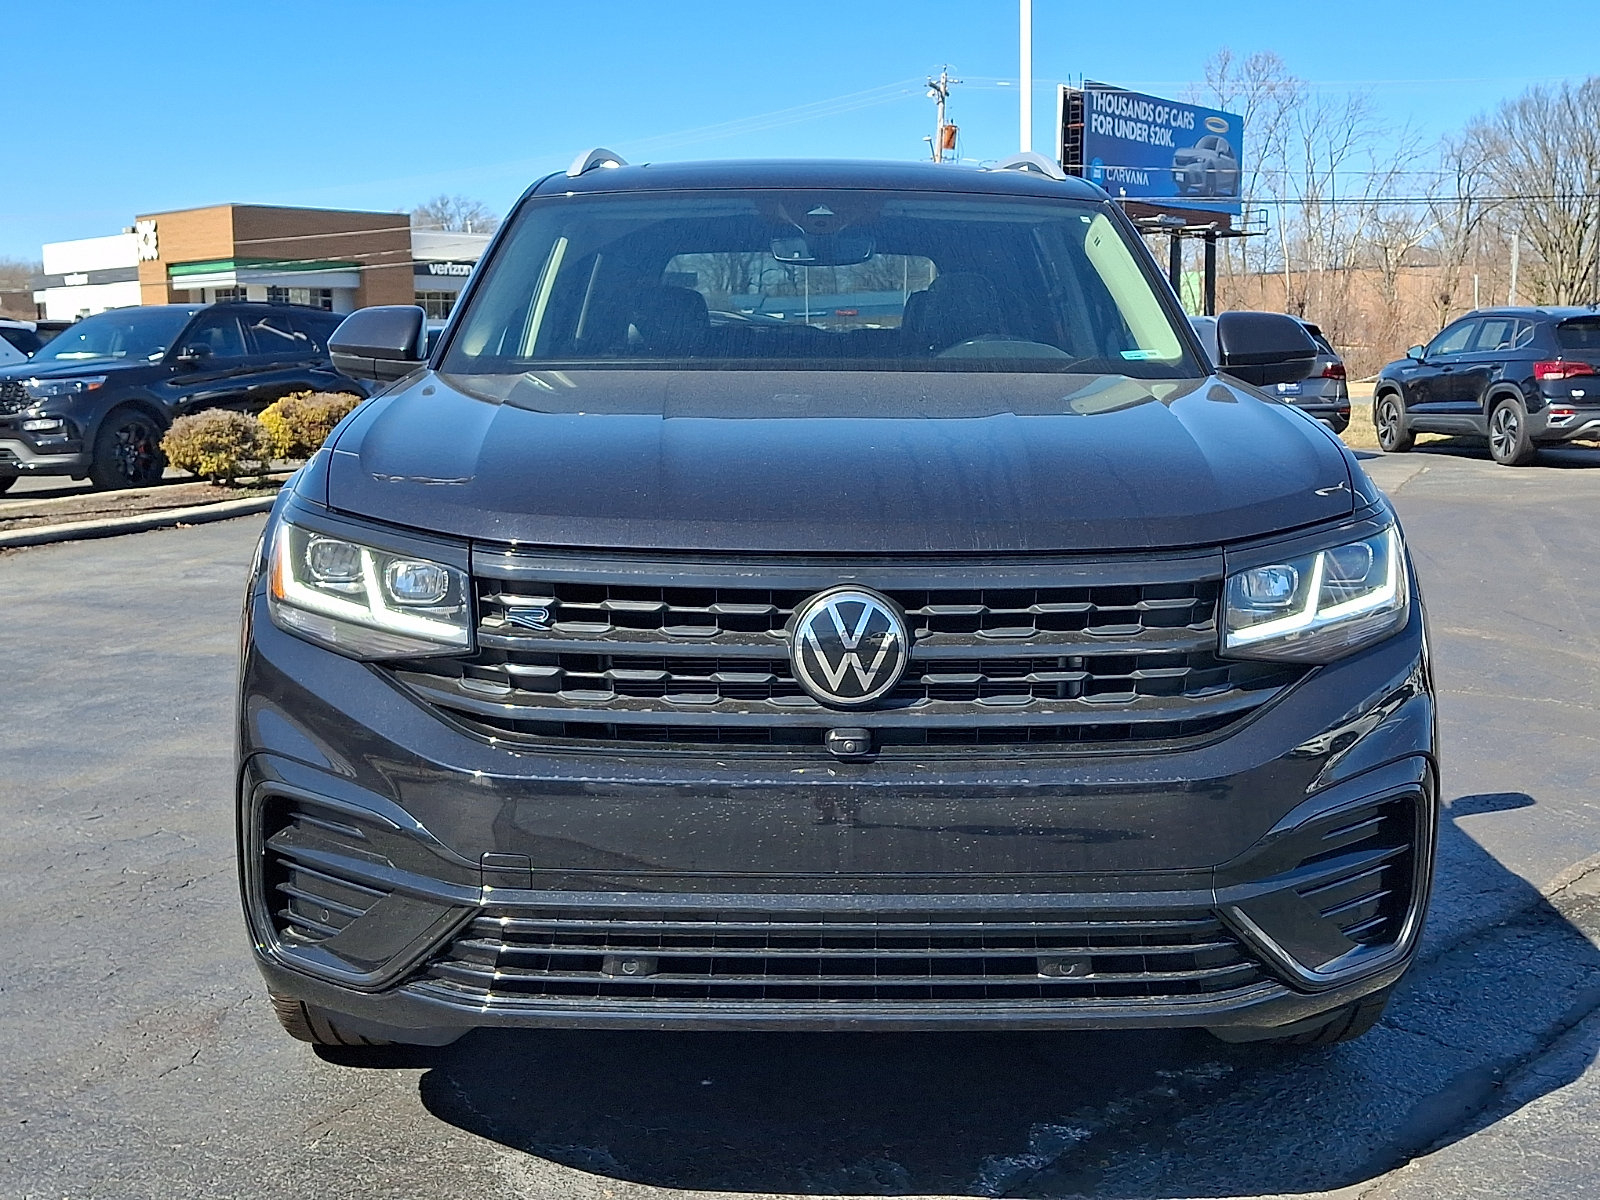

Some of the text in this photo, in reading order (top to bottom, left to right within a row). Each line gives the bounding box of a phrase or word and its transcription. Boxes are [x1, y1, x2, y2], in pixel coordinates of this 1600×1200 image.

[1092, 91, 1195, 130] THOUSANDS OF CARS
[1091, 113, 1175, 148] FOR UNDER $20K.
[1106, 168, 1149, 186] CARVANA
[428, 262, 474, 276] verizon
